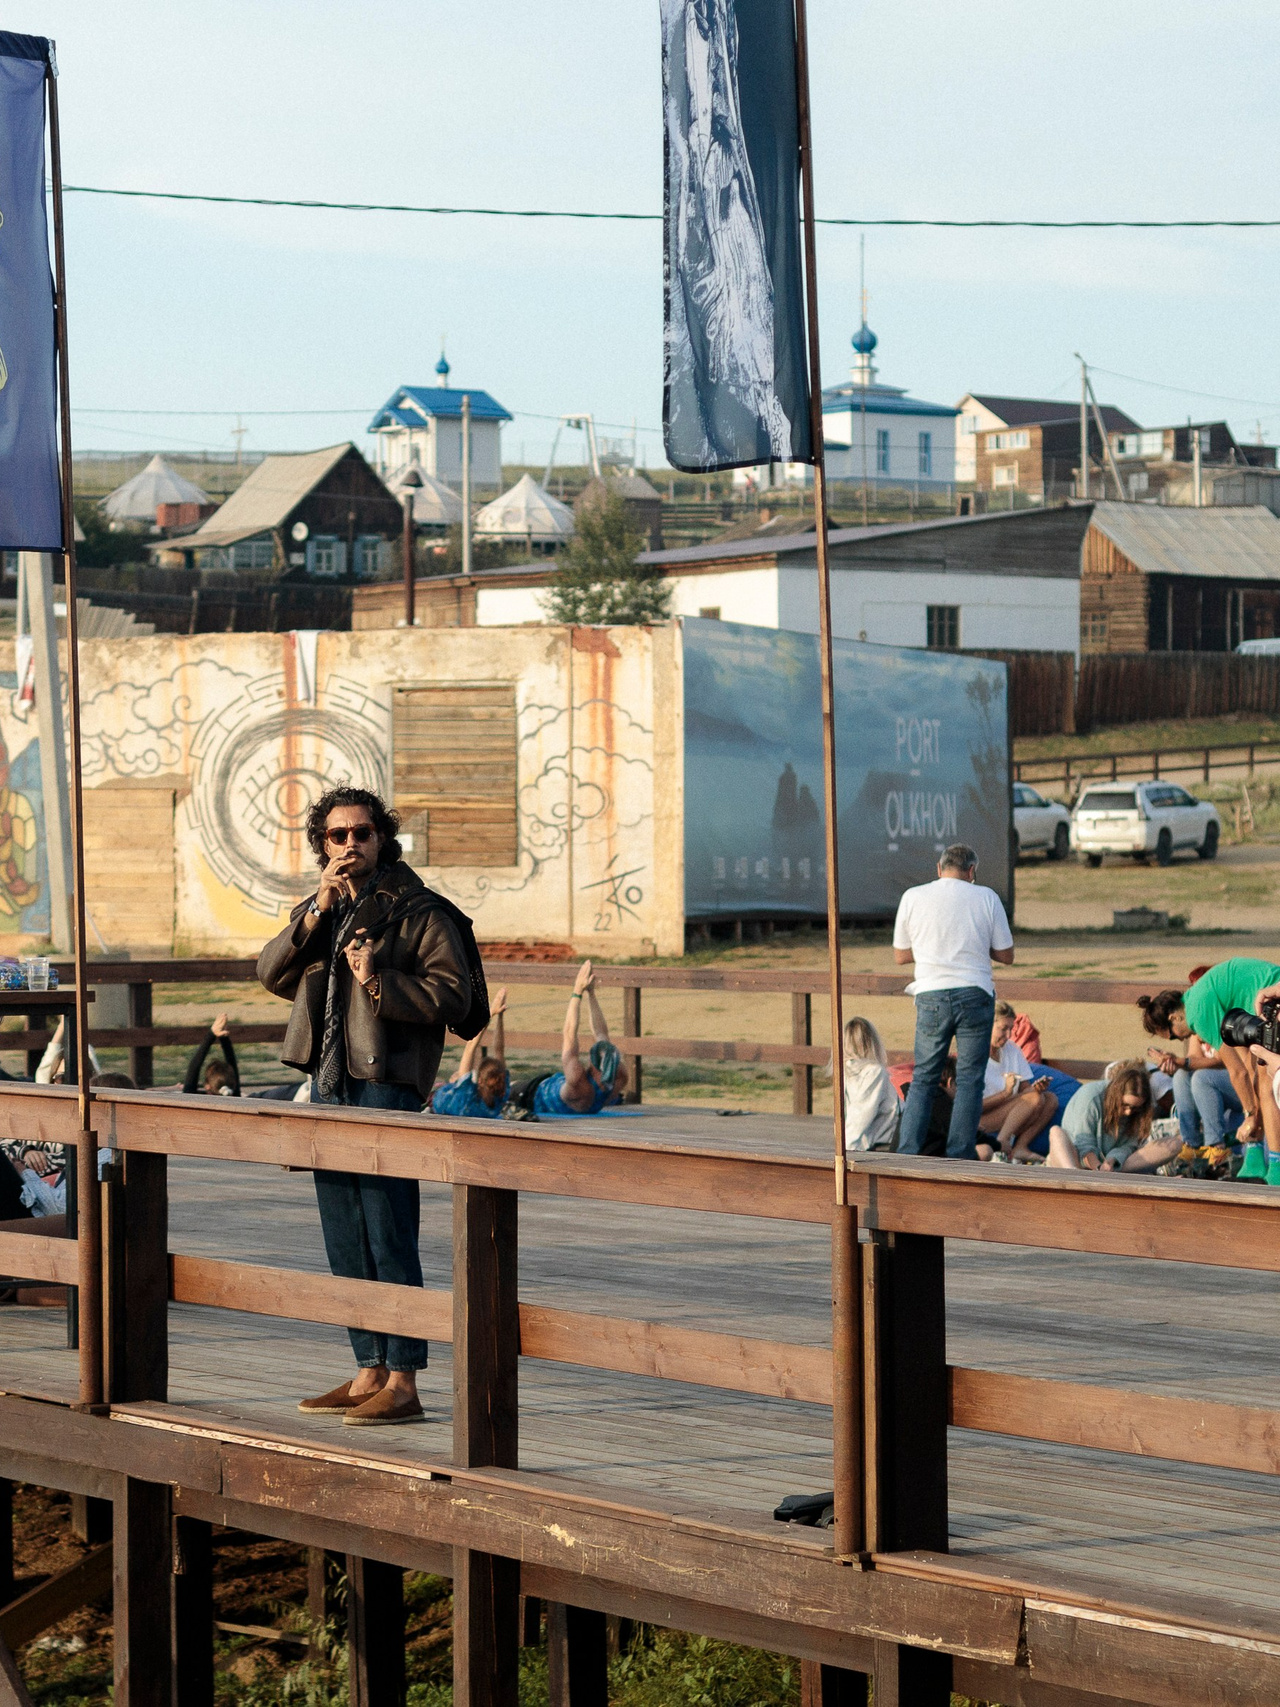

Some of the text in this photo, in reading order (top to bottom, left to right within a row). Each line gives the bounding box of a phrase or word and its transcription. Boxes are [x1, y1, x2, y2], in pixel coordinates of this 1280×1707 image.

[895, 717, 941, 764] PORT
[884, 790, 958, 838] OLKHON
[593, 912, 613, 932] 22
